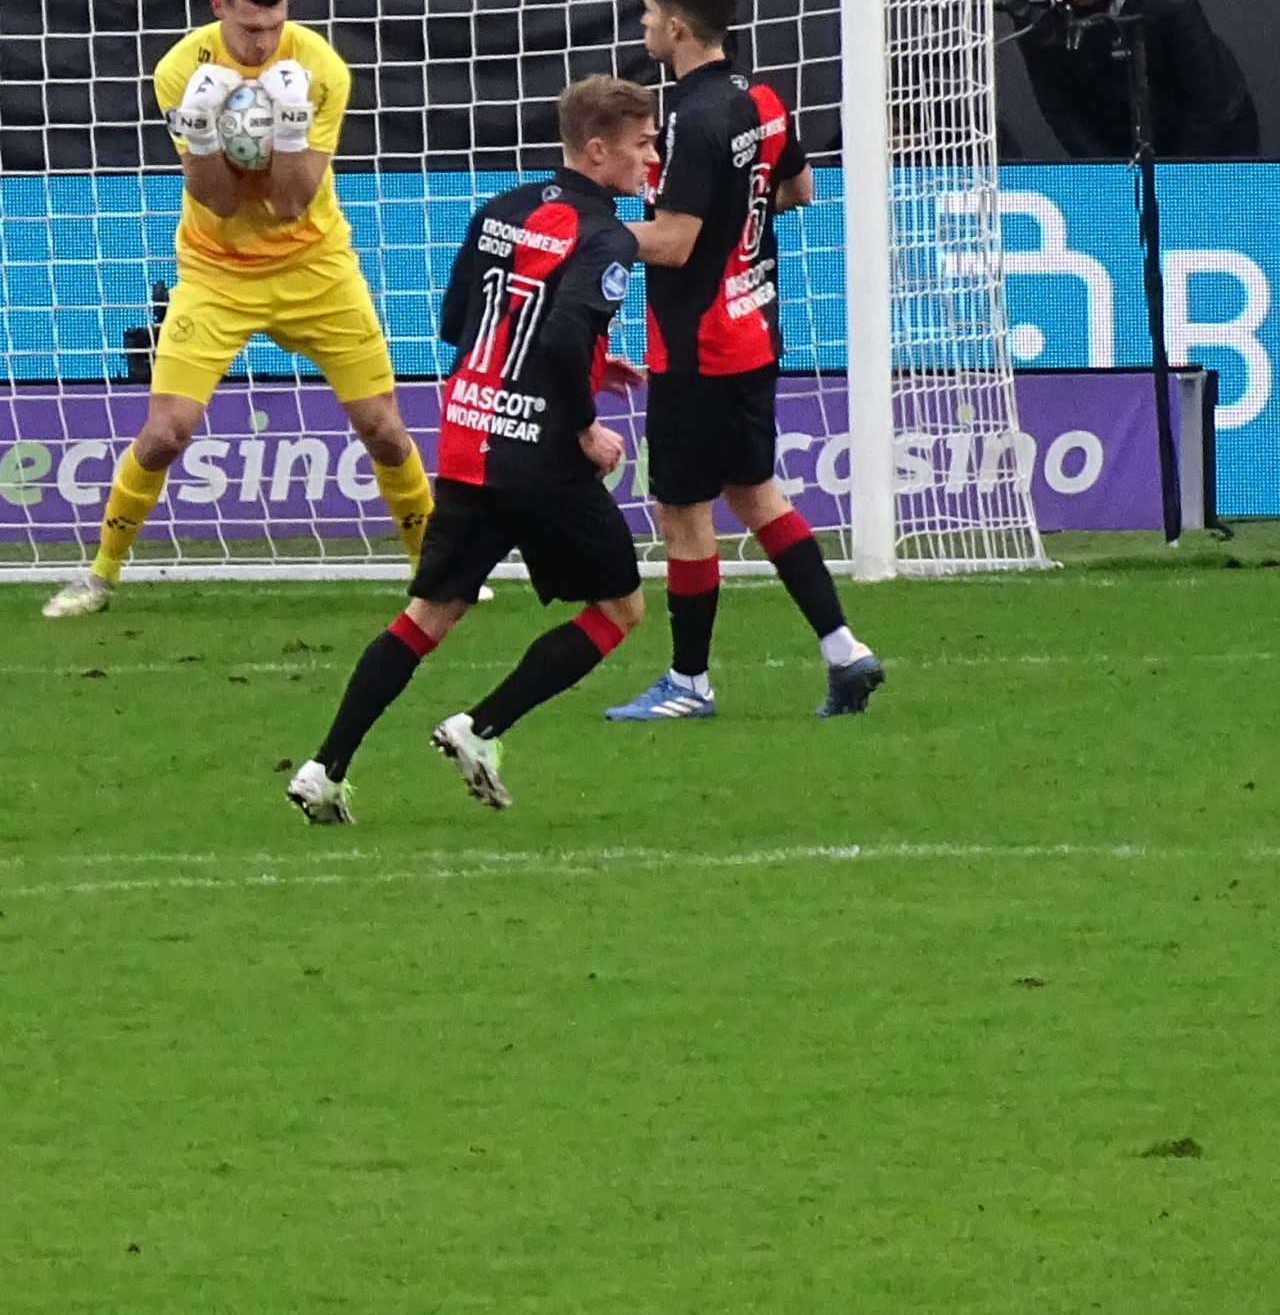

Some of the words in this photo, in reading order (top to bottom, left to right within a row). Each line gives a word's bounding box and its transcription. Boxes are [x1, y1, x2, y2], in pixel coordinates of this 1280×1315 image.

[478, 235, 512, 259] GROEP
[739, 162, 771, 262] 6
[468, 266, 546, 382] 17
[446, 403, 541, 444] WORKWEAR
